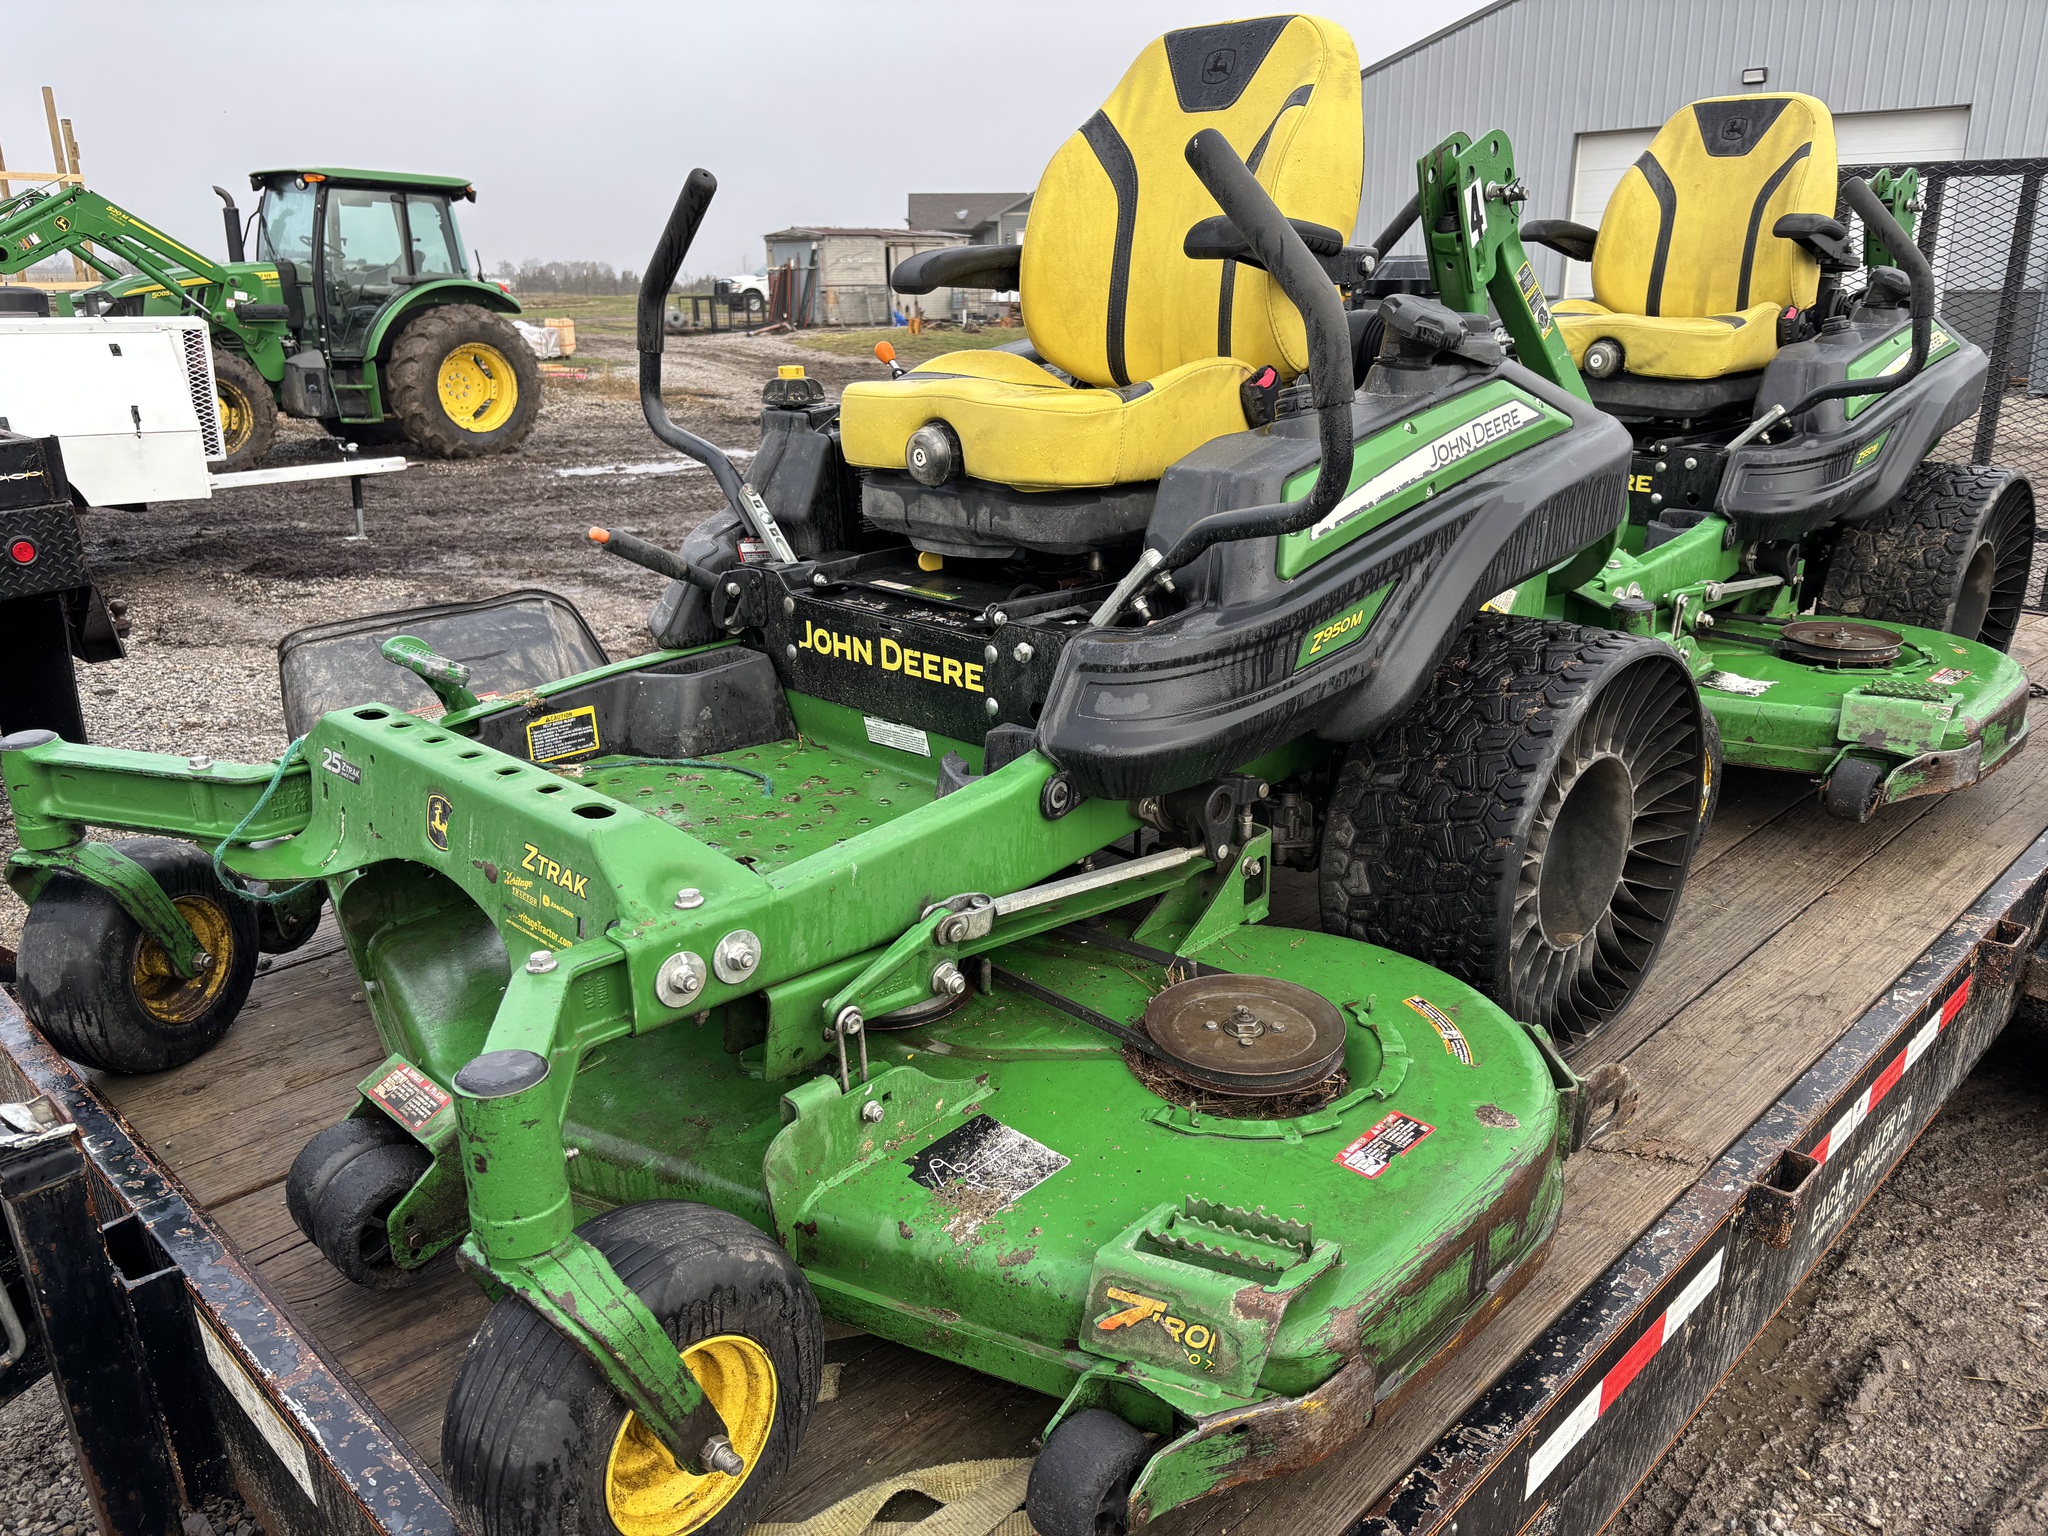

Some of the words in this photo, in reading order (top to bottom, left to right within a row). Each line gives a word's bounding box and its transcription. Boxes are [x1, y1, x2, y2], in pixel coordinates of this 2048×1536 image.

[1470, 183, 1485, 242] 4
[1430, 431, 1472, 470] JOHN
[1474, 408, 1522, 446] DEERE
[798, 620, 873, 667] JOHN
[880, 637, 985, 693] DEERE
[1308, 608, 1364, 656] Z950M
[550, 711, 573, 722] CAUTION
[322, 747, 342, 774] 25
[341, 761, 360, 779] ZTRAK
[521, 842, 590, 900] ZTRAK
[1810, 1168, 1850, 1234] EAGLE
[1851, 1114, 1897, 1185] TRAILER
[1896, 1095, 1913, 1130] CO.
